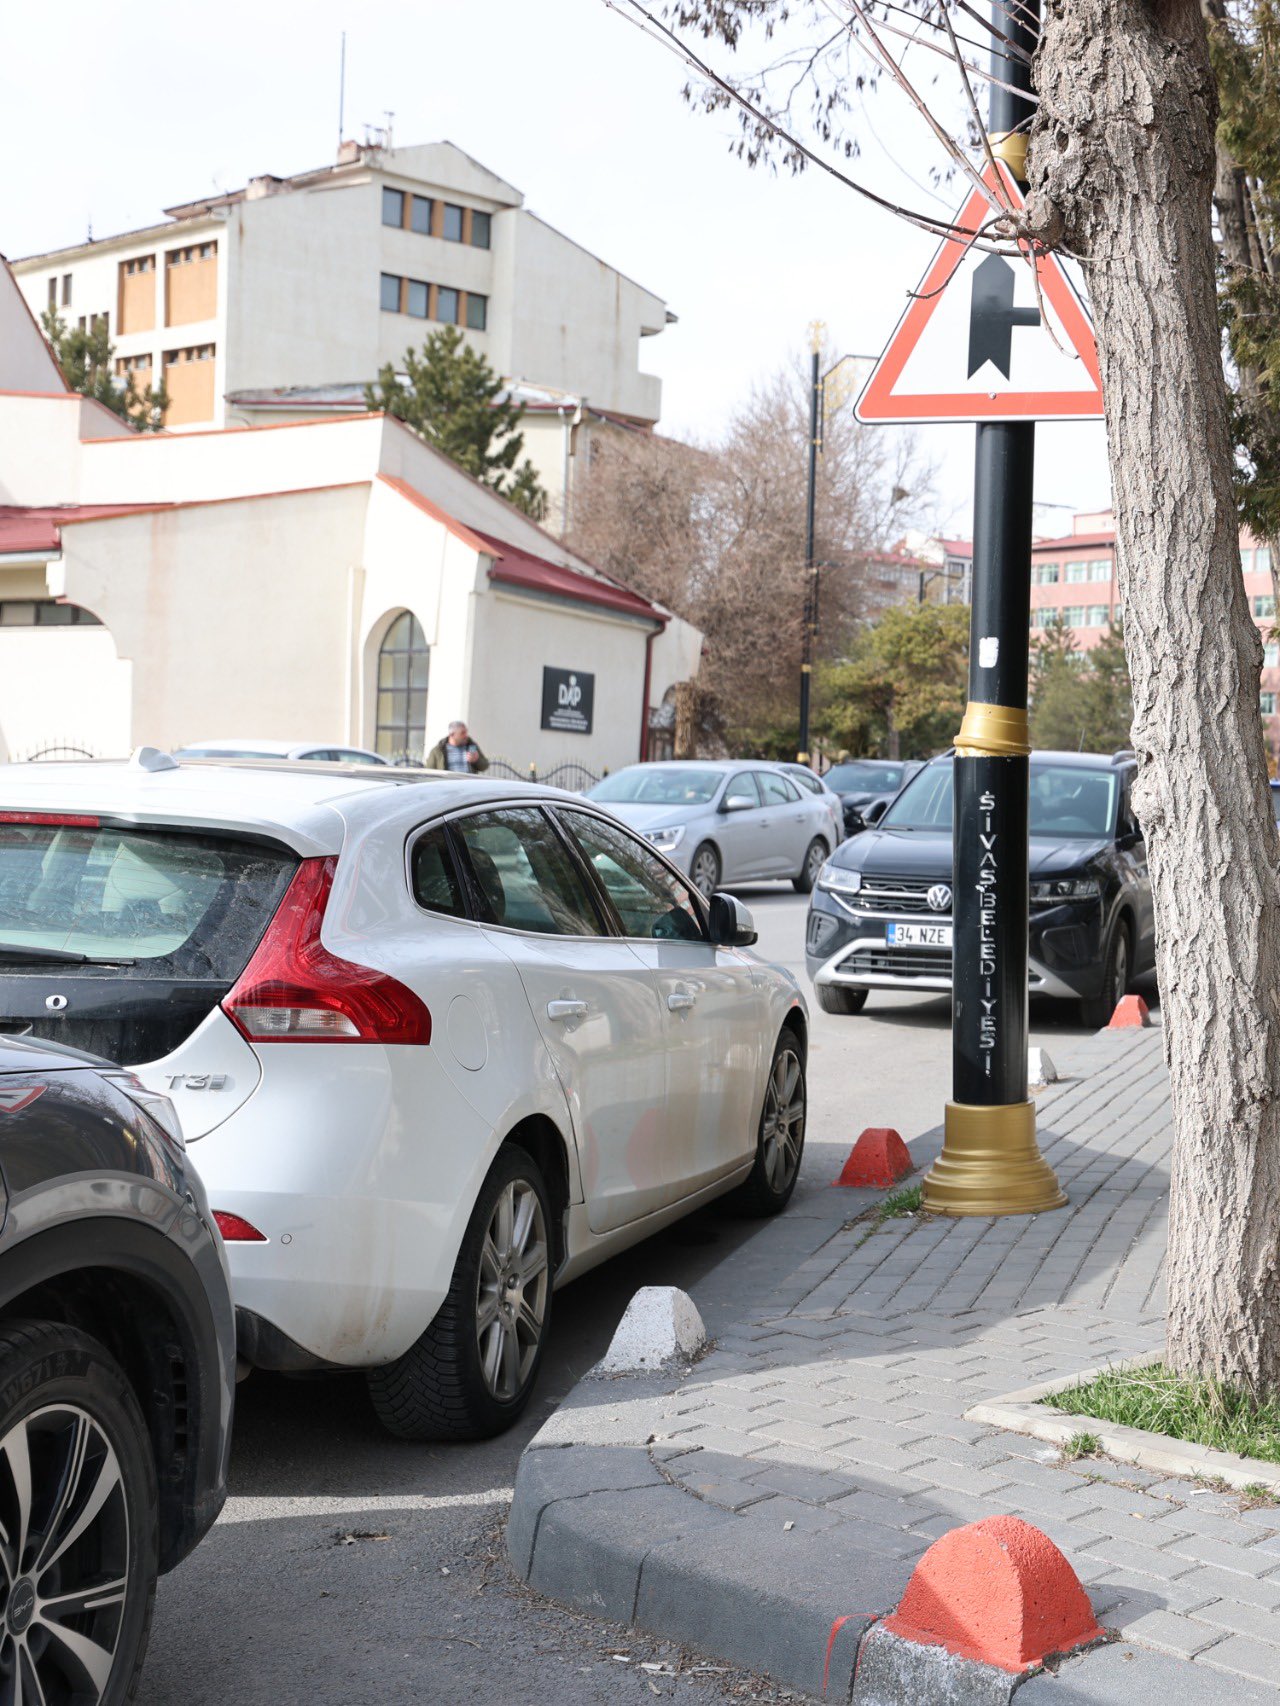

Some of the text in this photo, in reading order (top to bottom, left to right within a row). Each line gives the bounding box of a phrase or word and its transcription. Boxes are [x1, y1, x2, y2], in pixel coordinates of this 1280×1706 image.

[897, 926, 945, 944] 34 NZE
[164, 1074, 210, 1090] T3
